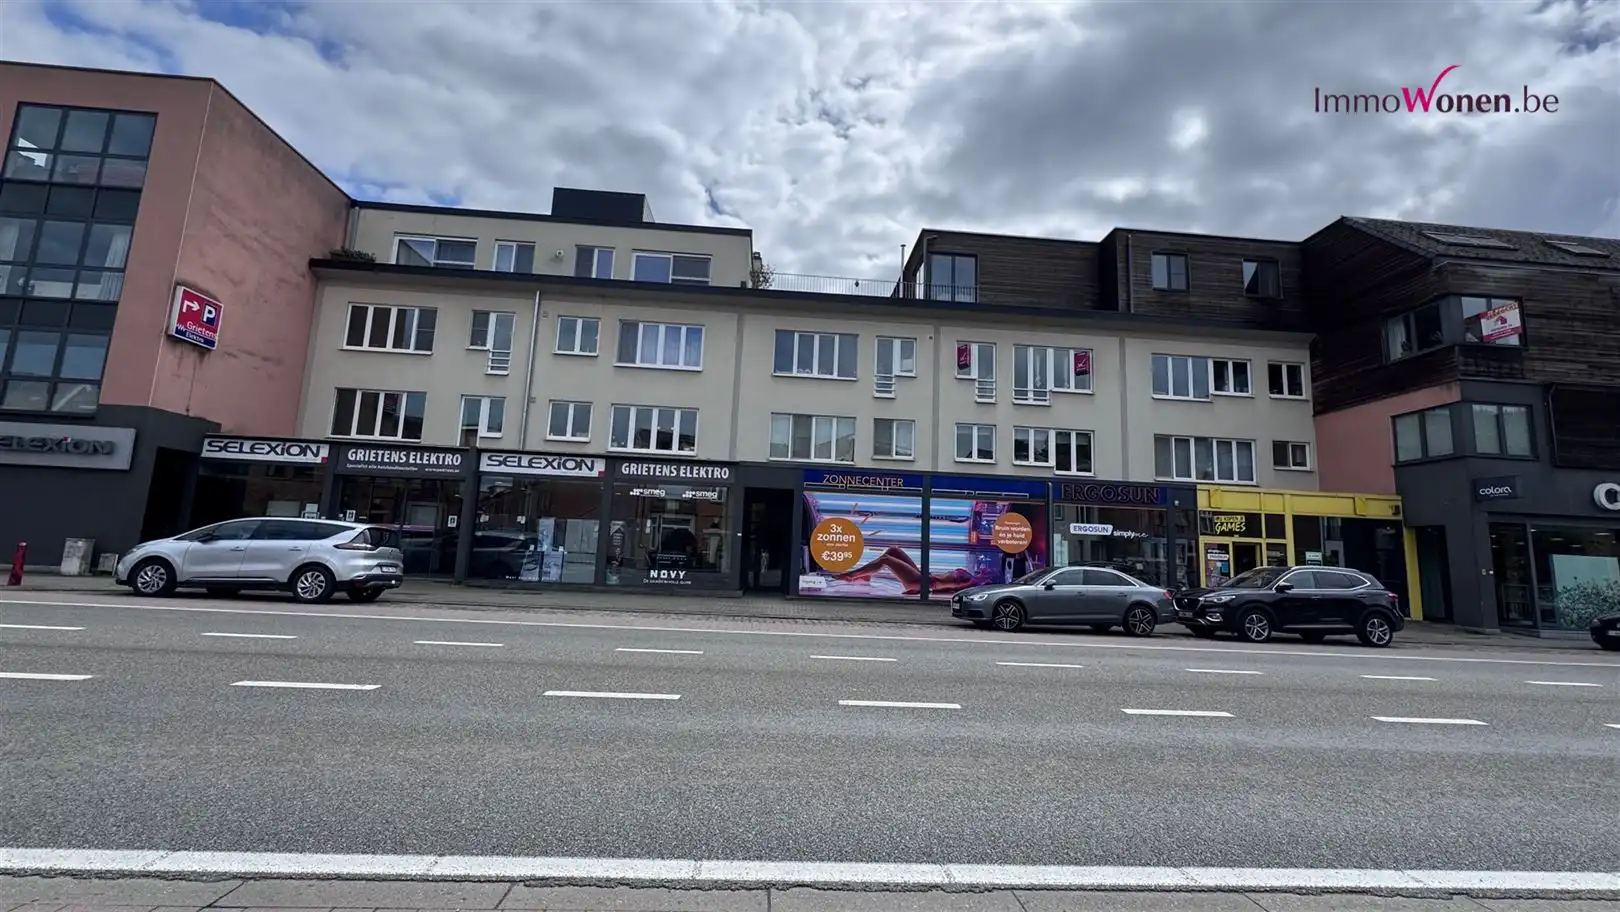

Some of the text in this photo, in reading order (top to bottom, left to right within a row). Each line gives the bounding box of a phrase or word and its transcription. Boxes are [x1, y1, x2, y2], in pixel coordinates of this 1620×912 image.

[203, 304, 216, 322] P
[347, 448, 462, 466] GRIETENS ELEKTRO
[621, 462, 730, 479] GRIETENS ELEKTRO
[822, 474, 904, 487] ZONNECENTER
[643, 488, 666, 497] smeg
[696, 490, 718, 500] smeg
[1061, 483, 1160, 504] ERGOSUN
[1479, 486, 1512, 495] colora
[830, 523, 843, 533] 3x
[1073, 525, 1109, 533] ERGOSUN
[1215, 522, 1246, 535] GAMES
[816, 533, 856, 543] zonnen
[649, 569, 687, 579] NOVY
